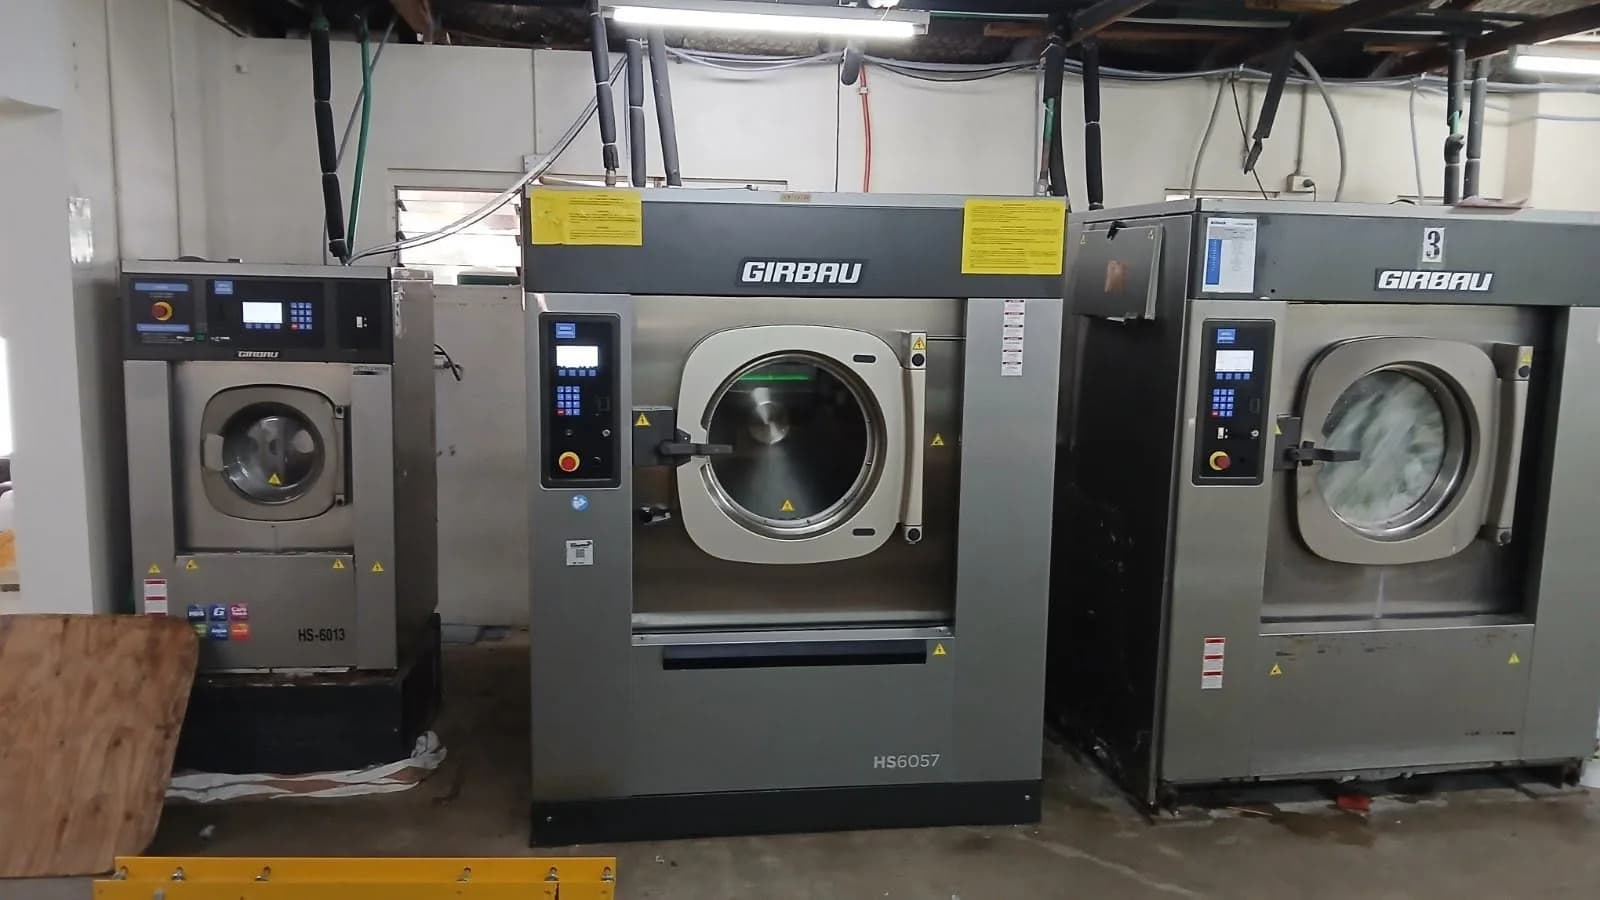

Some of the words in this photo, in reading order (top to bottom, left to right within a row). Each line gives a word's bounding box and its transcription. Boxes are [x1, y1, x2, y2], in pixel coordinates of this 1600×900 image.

[1426, 230, 1441, 260] 3
[741, 261, 862, 284] GIRBAU
[1378, 270, 1493, 291] GIRBAU
[298, 628, 345, 641] HS-6013
[873, 753, 941, 769] HS6057
